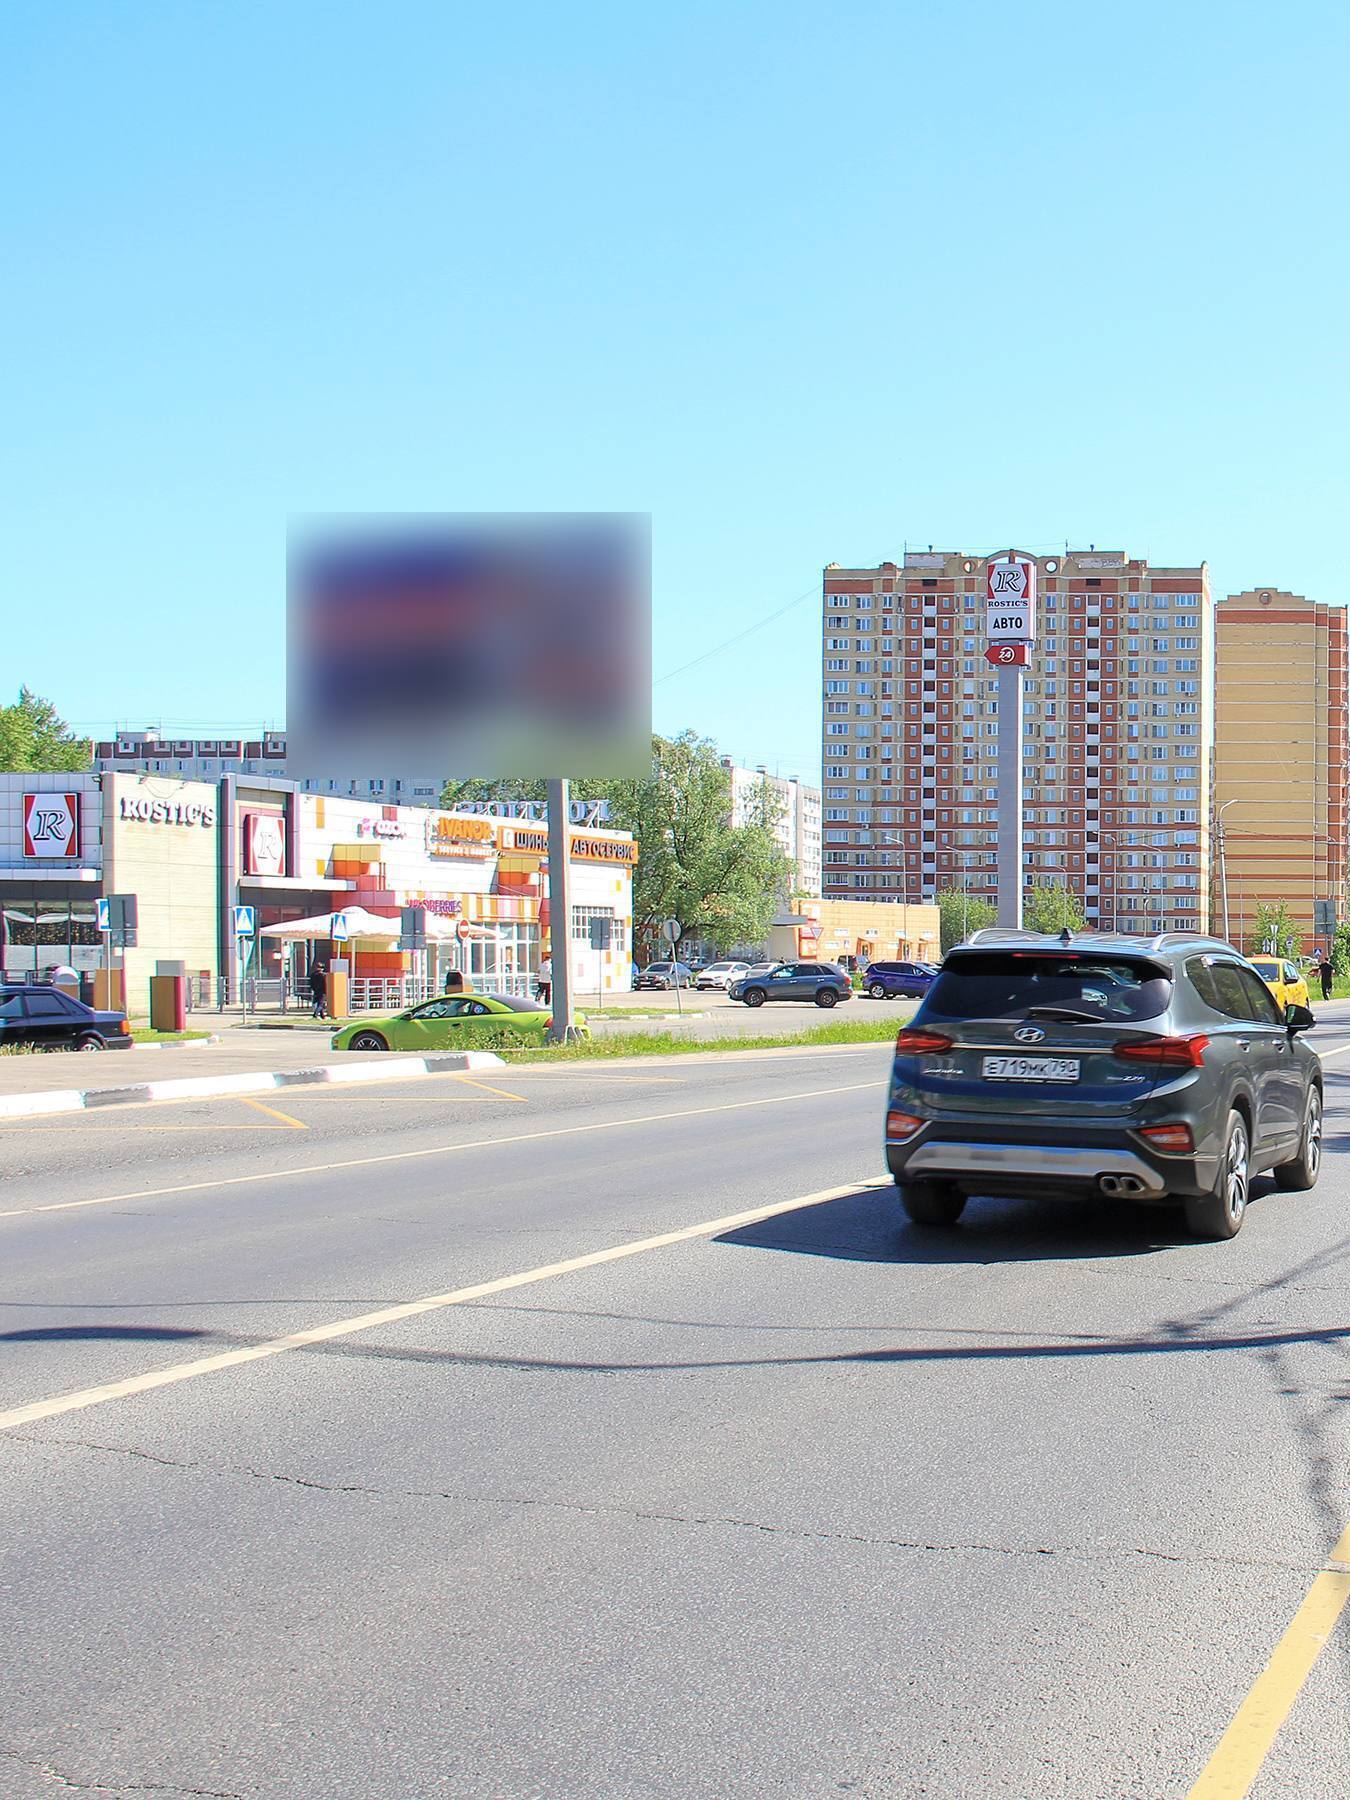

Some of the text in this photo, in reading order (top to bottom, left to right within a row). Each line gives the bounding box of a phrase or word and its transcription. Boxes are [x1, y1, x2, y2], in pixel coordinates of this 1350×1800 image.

[994, 571, 1021, 592] R
[988, 600, 1028, 608] ROSTIC'S
[993, 617, 1023, 629] АВТО
[120, 797, 217, 827] ROSTIC'S
[33, 810, 67, 841] R
[571, 838, 636, 861] АВТОСЕРВИС
